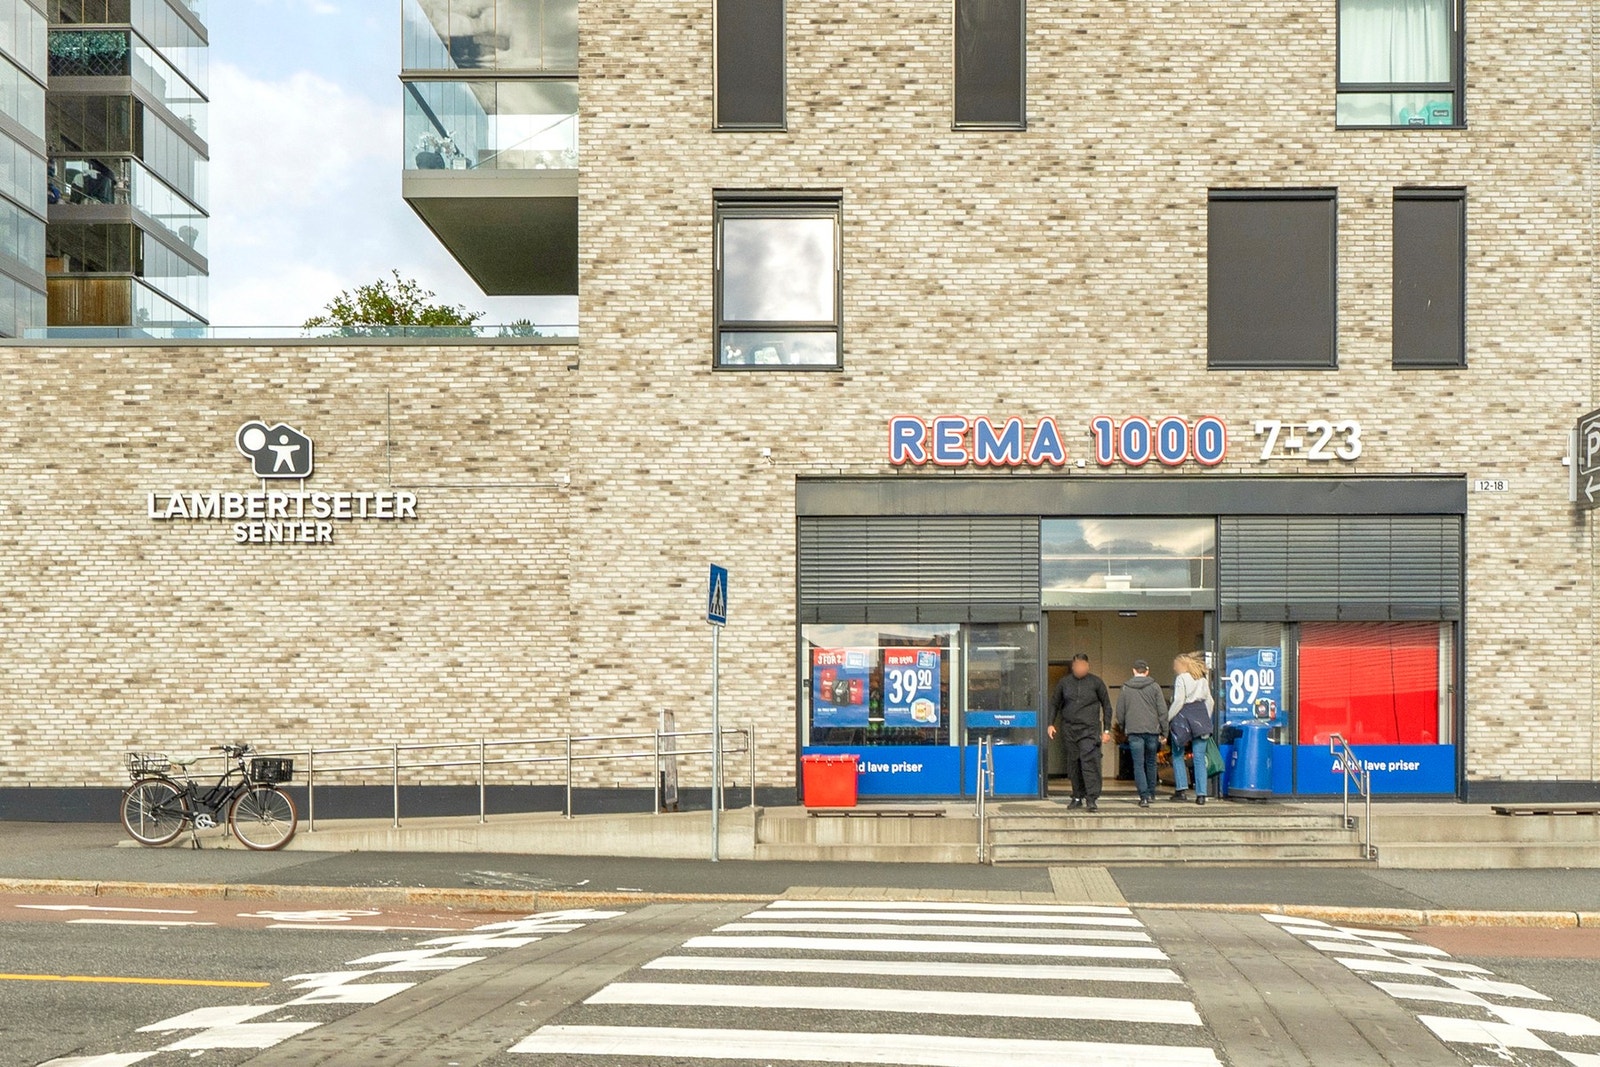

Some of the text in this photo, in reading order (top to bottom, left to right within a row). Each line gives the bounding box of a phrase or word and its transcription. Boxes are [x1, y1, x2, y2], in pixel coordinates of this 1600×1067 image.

[888, 415, 1227, 467] REMA 1000
[1254, 419, 1363, 461] 7-23
[1480, 481, 1504, 490] 12-18
[147, 492, 418, 520] LAMBERTSETER
[233, 521, 334, 544] SENTER
[888, 669, 932, 704] 39 90
[1229, 669, 1275, 705] 89 00
[867, 761, 890, 773] lave
[891, 761, 923, 774] priser
[1364, 759, 1387, 771] lave
[1388, 759, 1420, 773] priser
